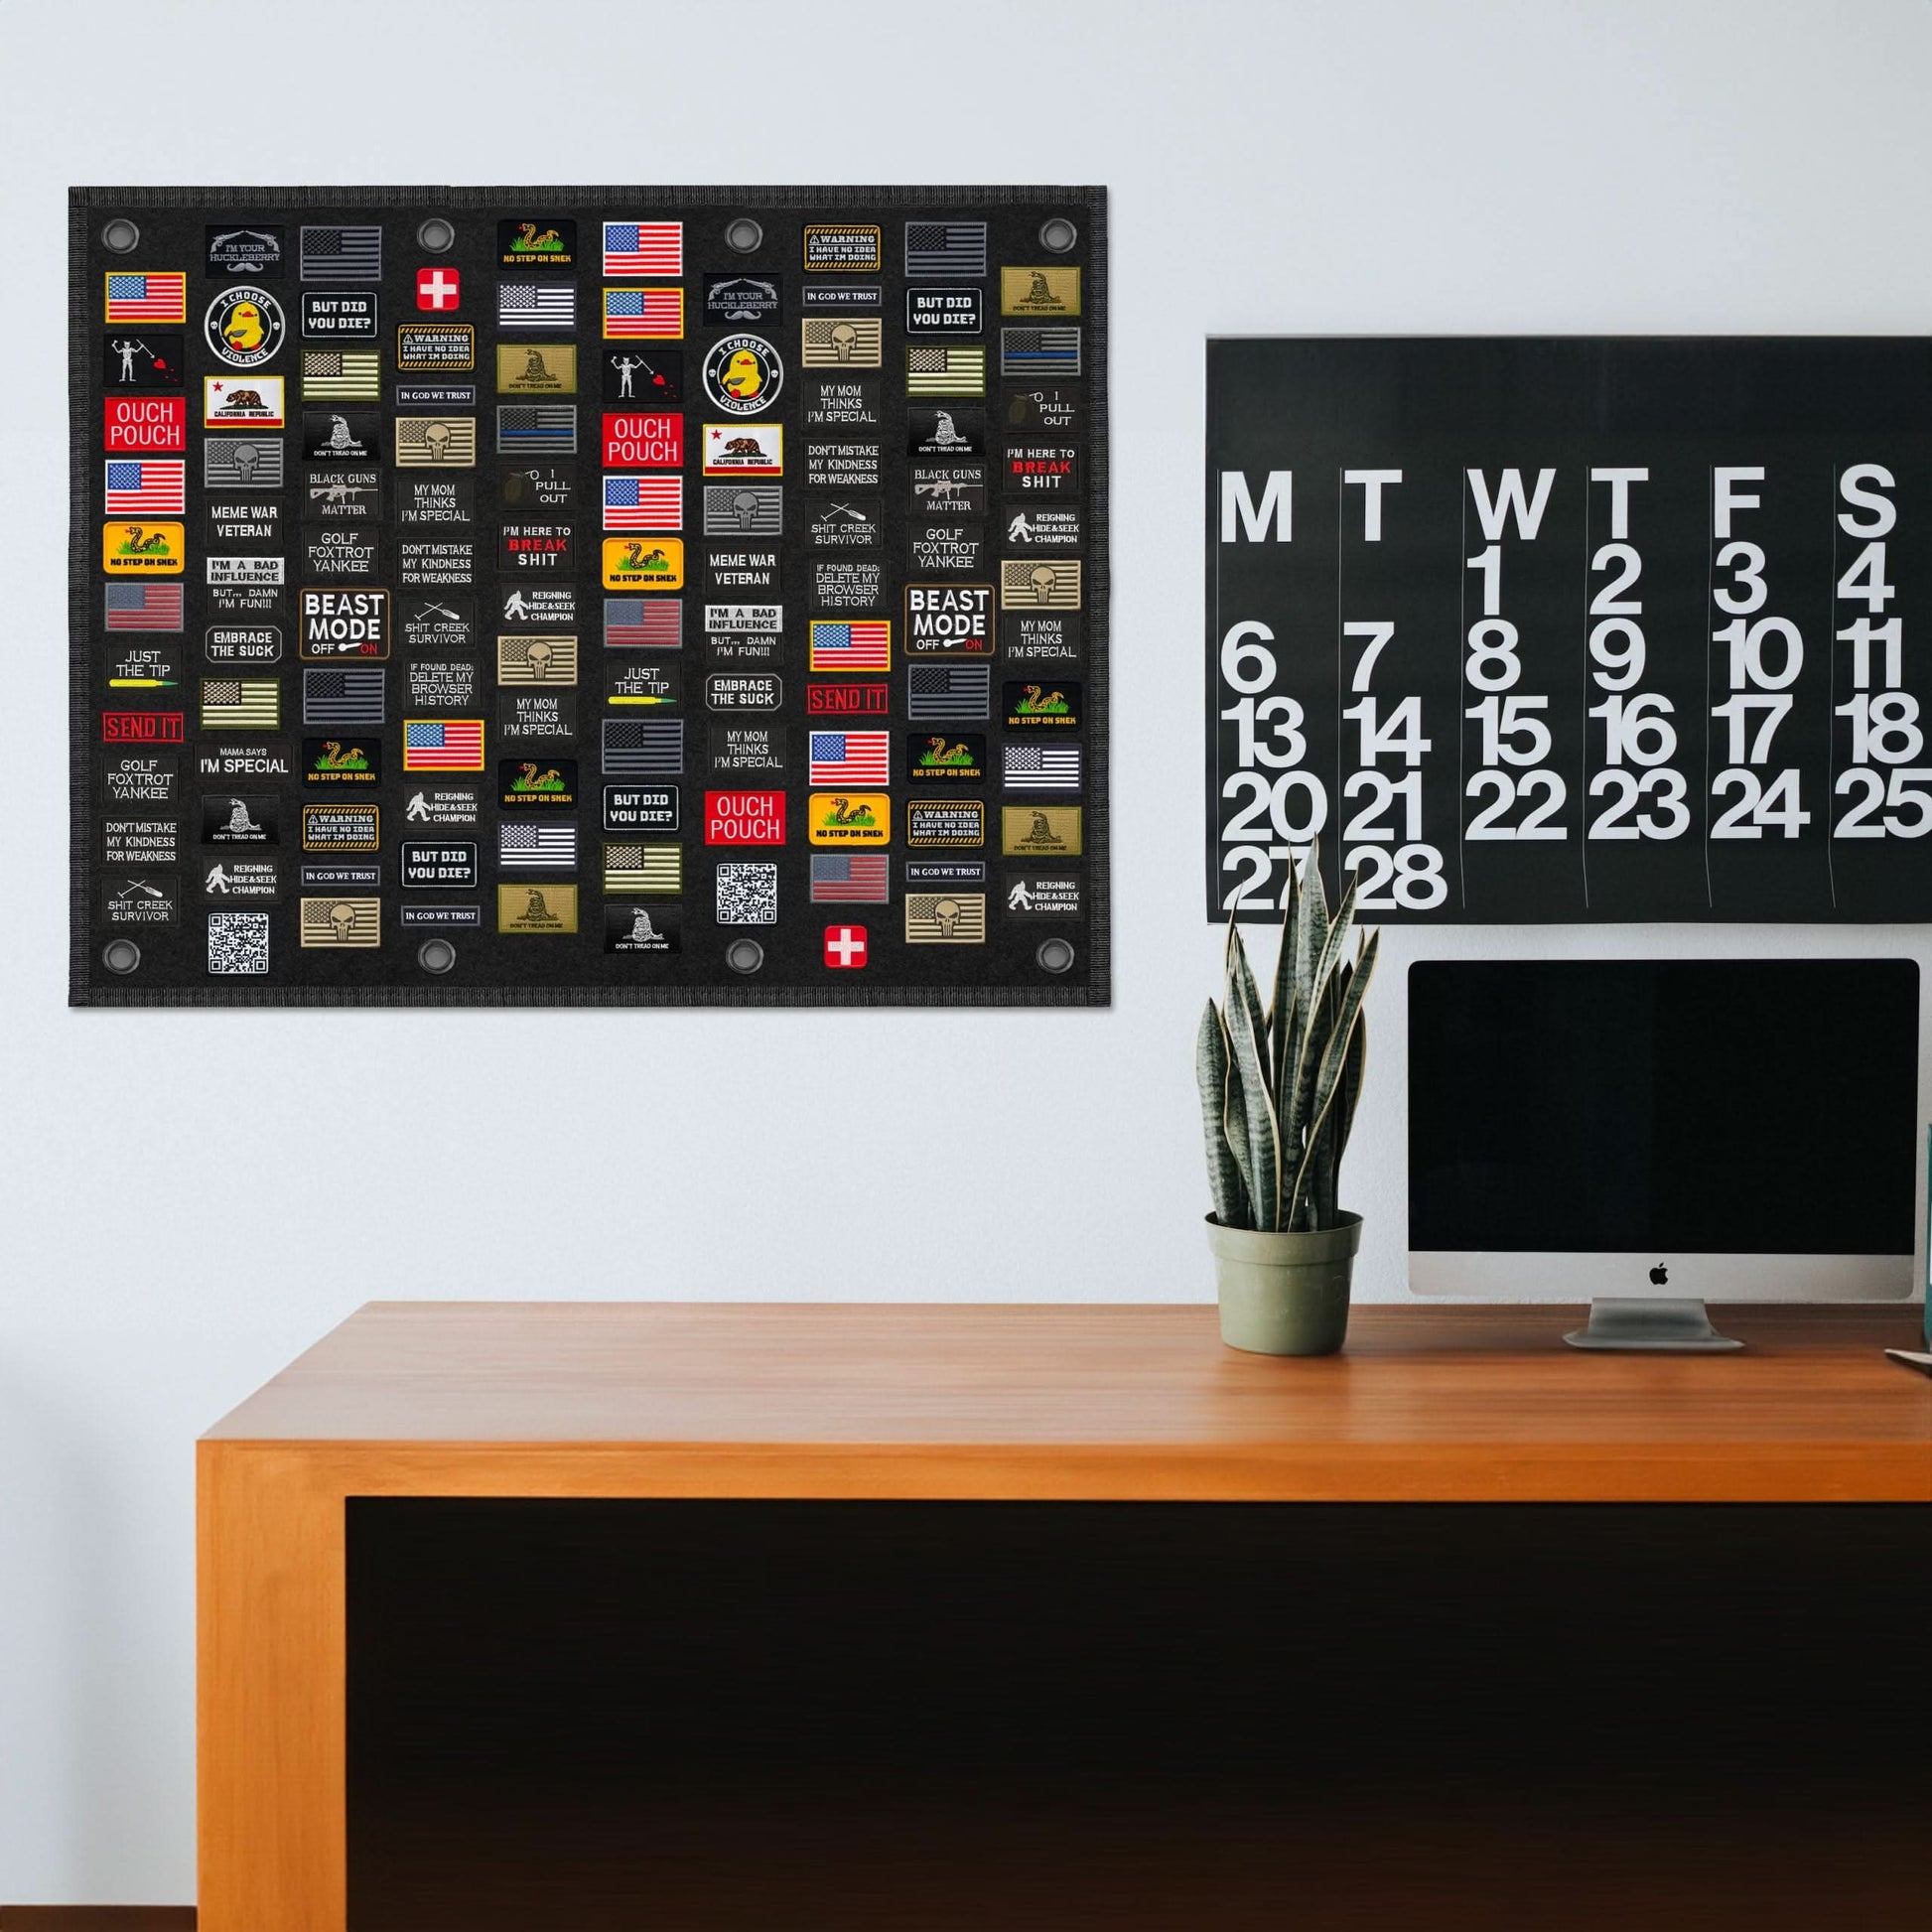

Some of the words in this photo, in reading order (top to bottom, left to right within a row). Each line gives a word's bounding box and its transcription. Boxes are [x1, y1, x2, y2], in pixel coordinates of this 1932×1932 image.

[720, 346, 728, 355] I
[728, 339, 769, 357] CHOOSE
[720, 395, 766, 411] VIOLENCE
[1040, 404, 1075, 413] PULL
[117, 402, 173, 422] OUCH
[1044, 417, 1071, 426] OUT
[111, 425, 179, 445] POUCH
[1013, 463, 1071, 474] BREAK
[310, 475, 344, 483] BLACK
[347, 475, 375, 483] GUNS
[1023, 477, 1061, 487] SHIT
[1221, 471, 1292, 542] M
[1345, 470, 1402, 541] T
[1466, 469, 1557, 540] W
[1591, 468, 1649, 539] T
[1715, 467, 1765, 537] F
[1837, 464, 1896, 538] S
[212, 506, 247, 518] MEME
[251, 506, 277, 518] WAR
[322, 505, 366, 514] MATTER
[217, 525, 271, 537] VETERAN
[811, 524, 835, 533] SHIT
[840, 524, 876, 533] CREEK
[815, 535, 872, 545] SURVIVOR
[926, 529, 963, 540] GOLF
[402, 545, 430, 555] DON'T
[432, 545, 473, 555] MISTAKE
[508, 540, 567, 551] BREAK
[913, 543, 979, 554] FOXTROT
[403, 559, 417, 569] MY
[422, 559, 471, 569] KINDNESS
[518, 554, 557, 565] SHIT
[918, 557, 973, 568] YANKEE
[403, 573, 420, 583] FOR
[422, 573, 471, 583] WEAKNESS
[1467, 545, 1501, 615] 1
[1589, 543, 1642, 615] 2
[1714, 542, 1768, 615] 3
[1838, 542, 1894, 613] 4
[305, 595, 384, 615] BEAST
[909, 591, 989, 611] BEAST
[711, 609, 728, 618] I'M
[736, 609, 744, 618] A
[753, 609, 776, 618] BAD
[309, 620, 380, 639] MODE
[913, 616, 985, 635] MODE
[214, 632, 272, 643] EMBRACE
[312, 643, 335, 654] OFF
[360, 643, 377, 654] ON
[916, 639, 939, 650] OFF
[965, 639, 982, 650] ON
[125, 651, 160, 662] JUST
[211, 645, 235, 657] THE
[239, 645, 274, 657] SUCK
[1221, 621, 1277, 694] 6
[1344, 621, 1394, 692] 7
[1465, 619, 1521, 692] 8
[1589, 618, 1646, 691] 9
[1713, 617, 1804, 690] 10
[1837, 618, 1902, 688] 11
[116, 665, 144, 676] THE
[150, 665, 170, 676] TIP
[410, 672, 453, 682] DELETE
[457, 672, 474, 682] MY
[412, 684, 473, 693] BROWSER
[415, 696, 469, 705] HISTORY
[517, 698, 531, 709] MY
[533, 698, 557, 709] MOM
[812, 690, 862, 709] SEND
[866, 690, 884, 709] IT
[516, 711, 558, 722] THINKS
[504, 724, 519, 735] I'M
[522, 724, 572, 735] SPECIAL
[1221, 696, 1307, 767] 13
[1343, 696, 1432, 766] 14
[1465, 696, 1552, 766] 15
[1589, 693, 1677, 765] 16
[1711, 694, 1794, 763] 17
[1835, 692, 1923, 763] 18
[121, 760, 158, 771] GOLF
[201, 759, 219, 772] I'M
[224, 759, 288, 772] SPECIAL
[108, 774, 174, 785] FOXTROT
[113, 788, 168, 799] YANKEE
[615, 795, 639, 805] BUT
[643, 795, 668, 805] DID
[1222, 770, 1327, 842] 20
[1343, 770, 1422, 840] 21
[1465, 769, 1568, 840] 22
[1588, 767, 1690, 840] 23
[1710, 767, 1811, 839] 24
[1834, 767, 1932, 838] 25
[717, 796, 772, 816] OUCH
[611, 811, 637, 822] YOU
[640, 811, 672, 822] DIE?
[711, 819, 778, 839] POUCH
[1344, 844, 1448, 909] 28
